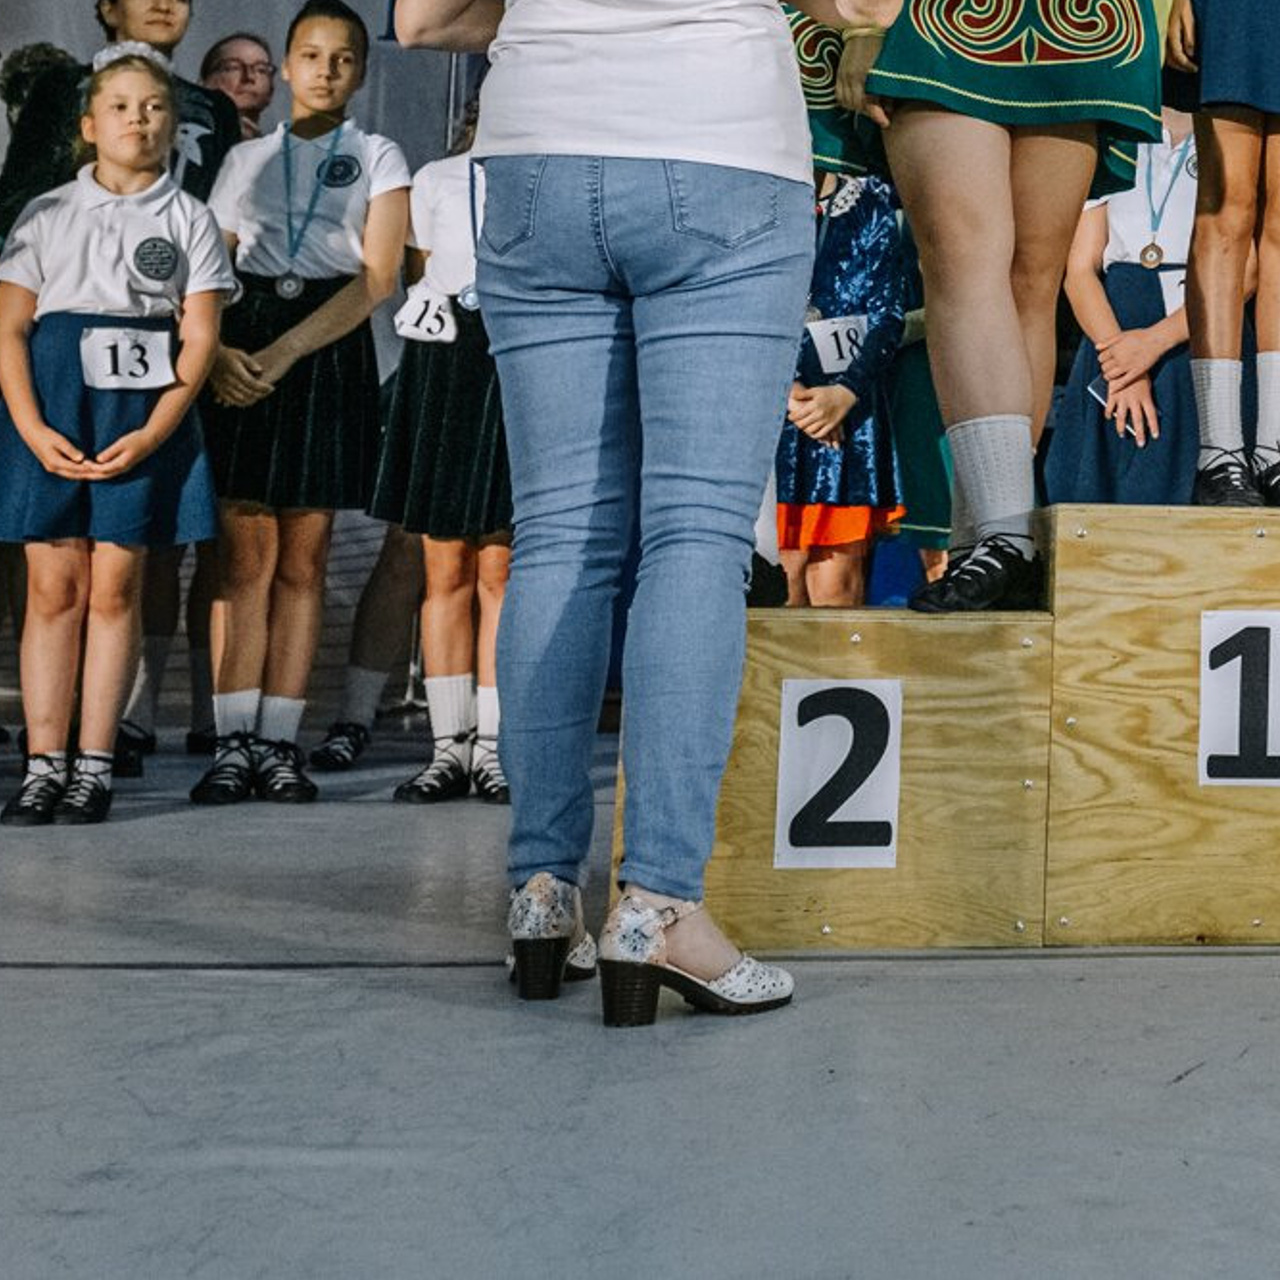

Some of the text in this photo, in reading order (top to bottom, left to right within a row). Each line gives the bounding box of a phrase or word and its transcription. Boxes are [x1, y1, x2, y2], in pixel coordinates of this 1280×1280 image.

[412, 300, 447, 336] 15
[103, 343, 150, 378] 13
[830, 328, 861, 361] 18
[788, 686, 893, 849] 2
